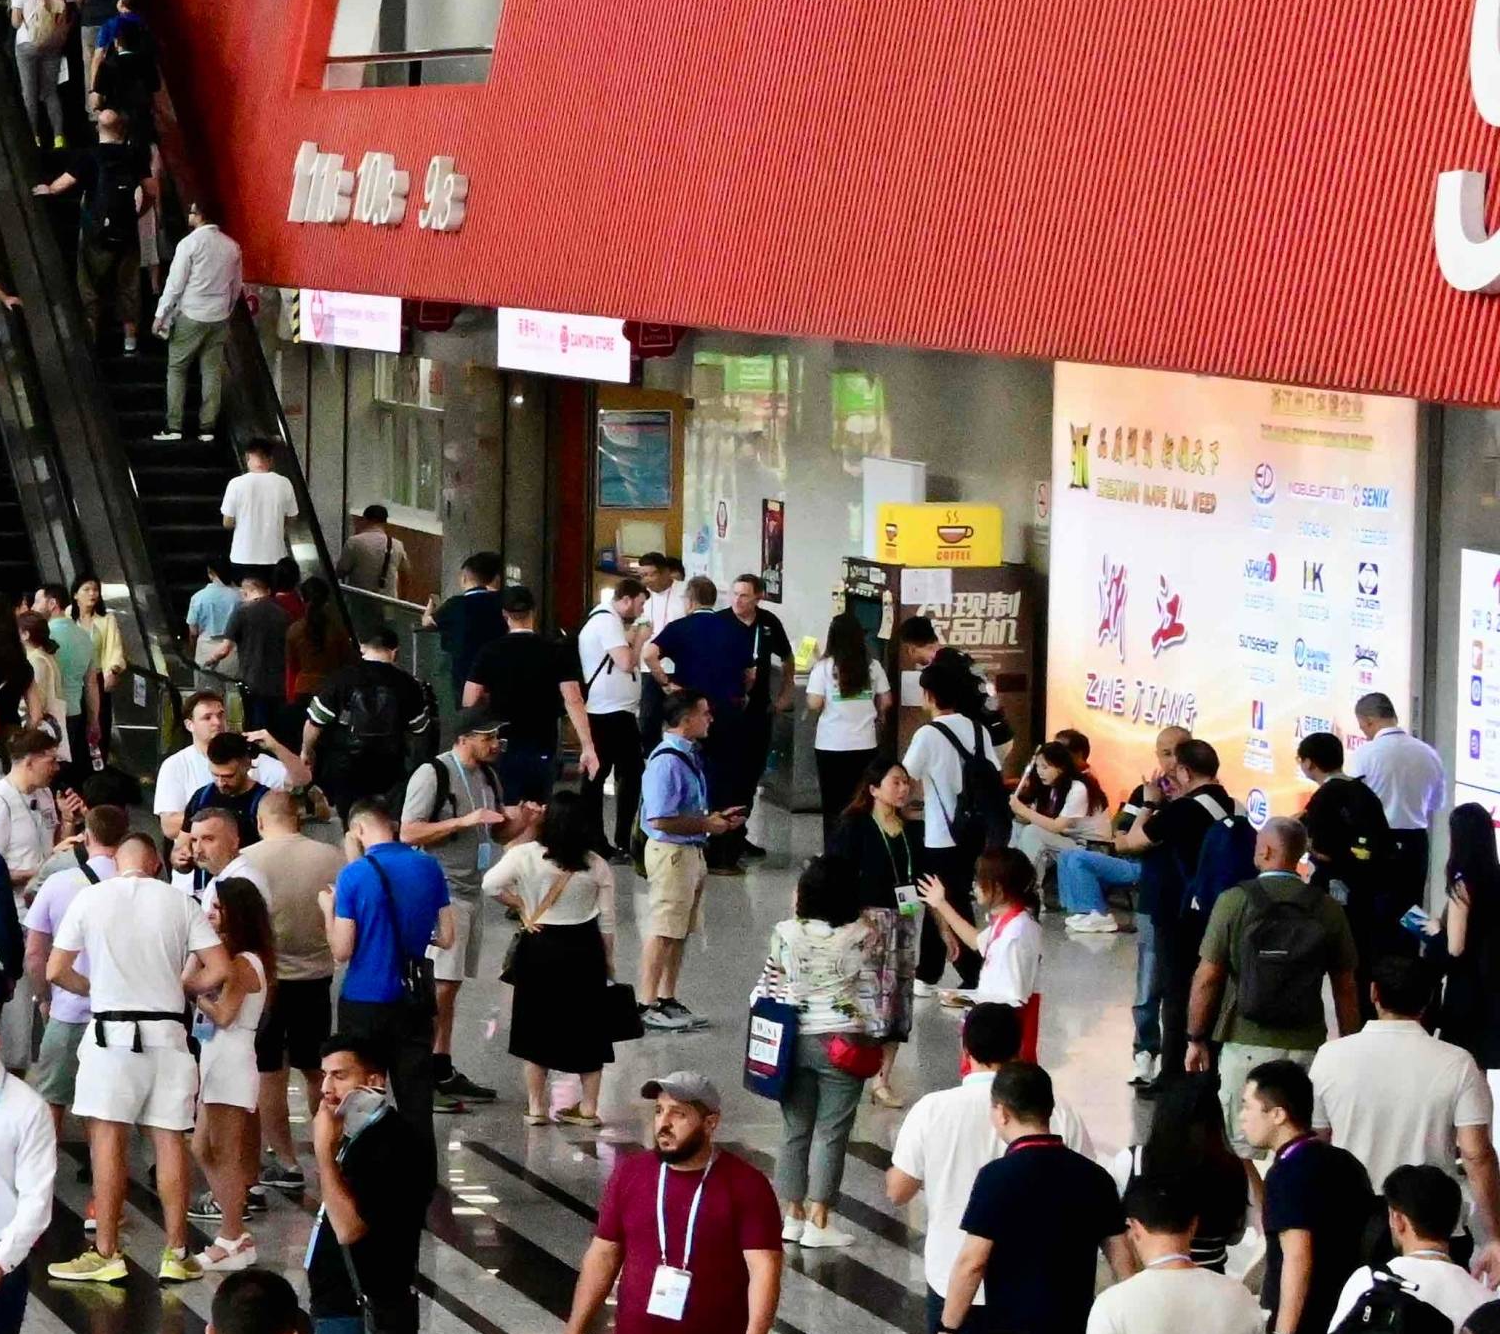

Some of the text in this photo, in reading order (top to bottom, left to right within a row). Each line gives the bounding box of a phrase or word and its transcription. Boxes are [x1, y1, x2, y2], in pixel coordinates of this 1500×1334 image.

[418, 155, 470, 232] 9.3
[1361, 486, 1390, 509] SENIX
[1086, 672, 1126, 715] ZHE
